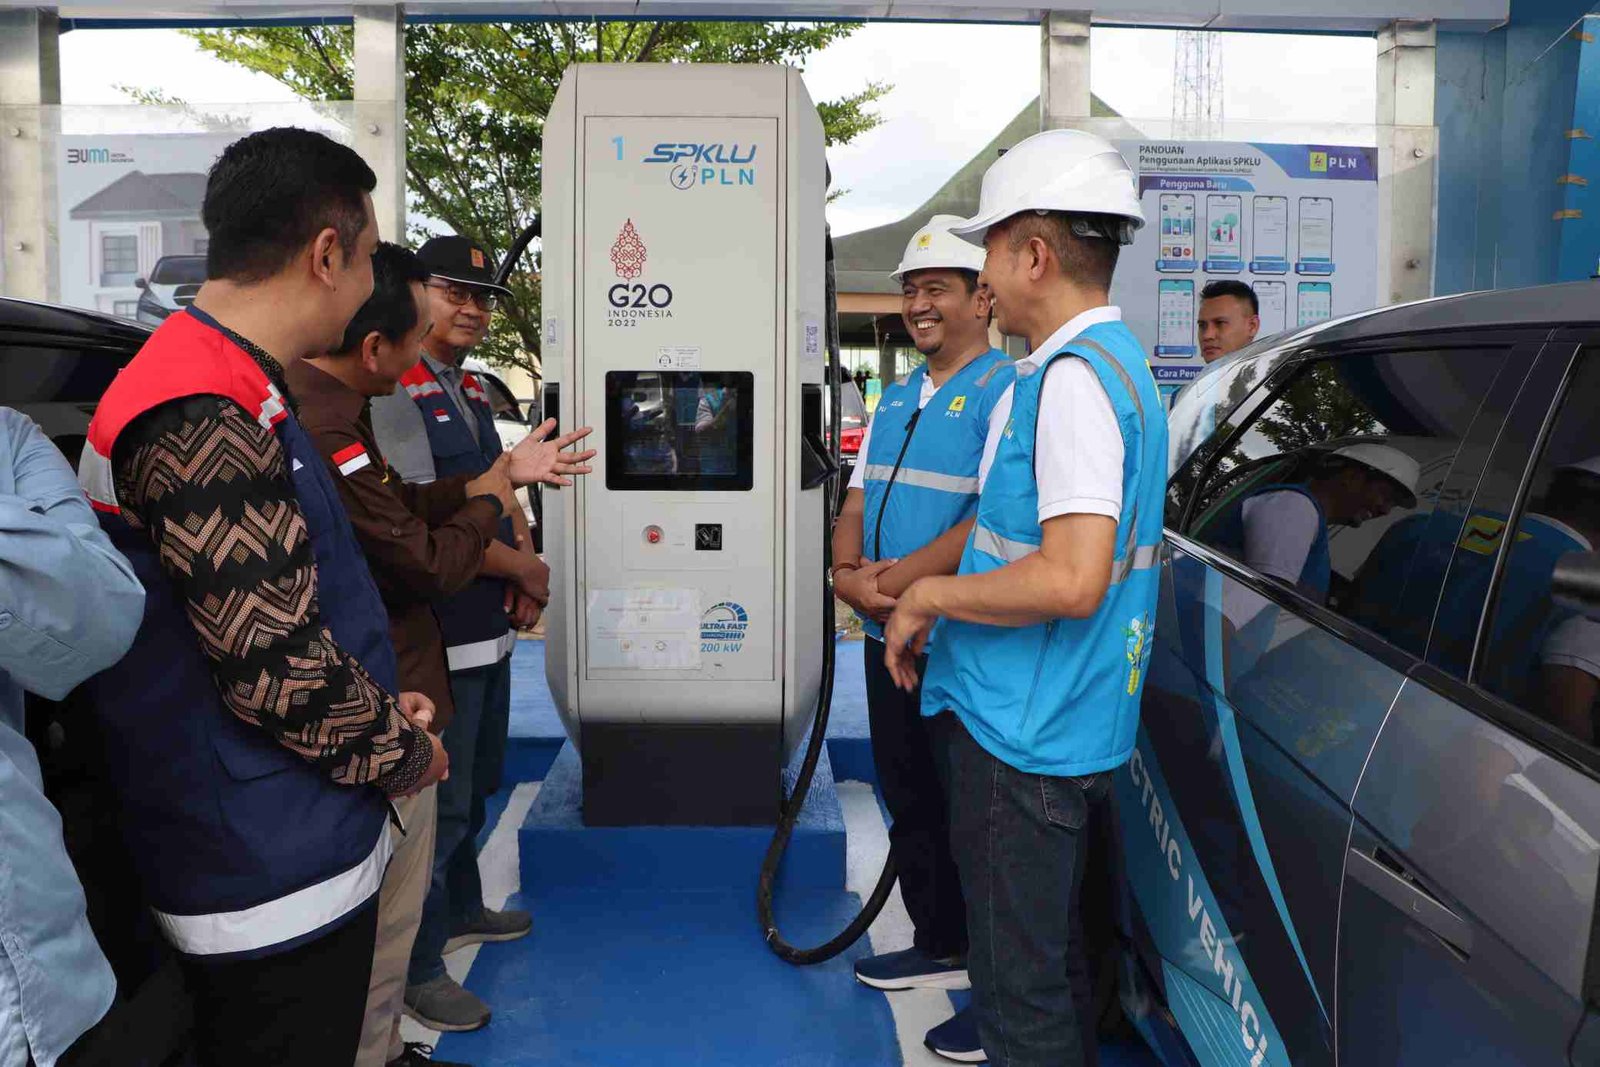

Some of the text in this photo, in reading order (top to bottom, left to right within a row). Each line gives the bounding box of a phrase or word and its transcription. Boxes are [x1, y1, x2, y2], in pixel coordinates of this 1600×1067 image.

[611, 136, 756, 163] 1 SPKLU
[1139, 145, 1184, 155] PANDUAN
[1139, 155, 1261, 167] Penggunaan Aplikasi SPKLU
[1329, 156, 1357, 168] PLN
[701, 168, 754, 185] PLN
[1160, 179, 1228, 190] Pengguna Baru
[608, 283, 673, 308] G20
[608, 309, 673, 318] INDONESIA
[608, 319, 636, 327] 2022
[1157, 369, 1178, 378] Cara
[944, 410, 961, 418] PLN
[700, 642, 742, 652] 200 kW
[1130, 748, 1268, 1067] CTRIC VEHICL
